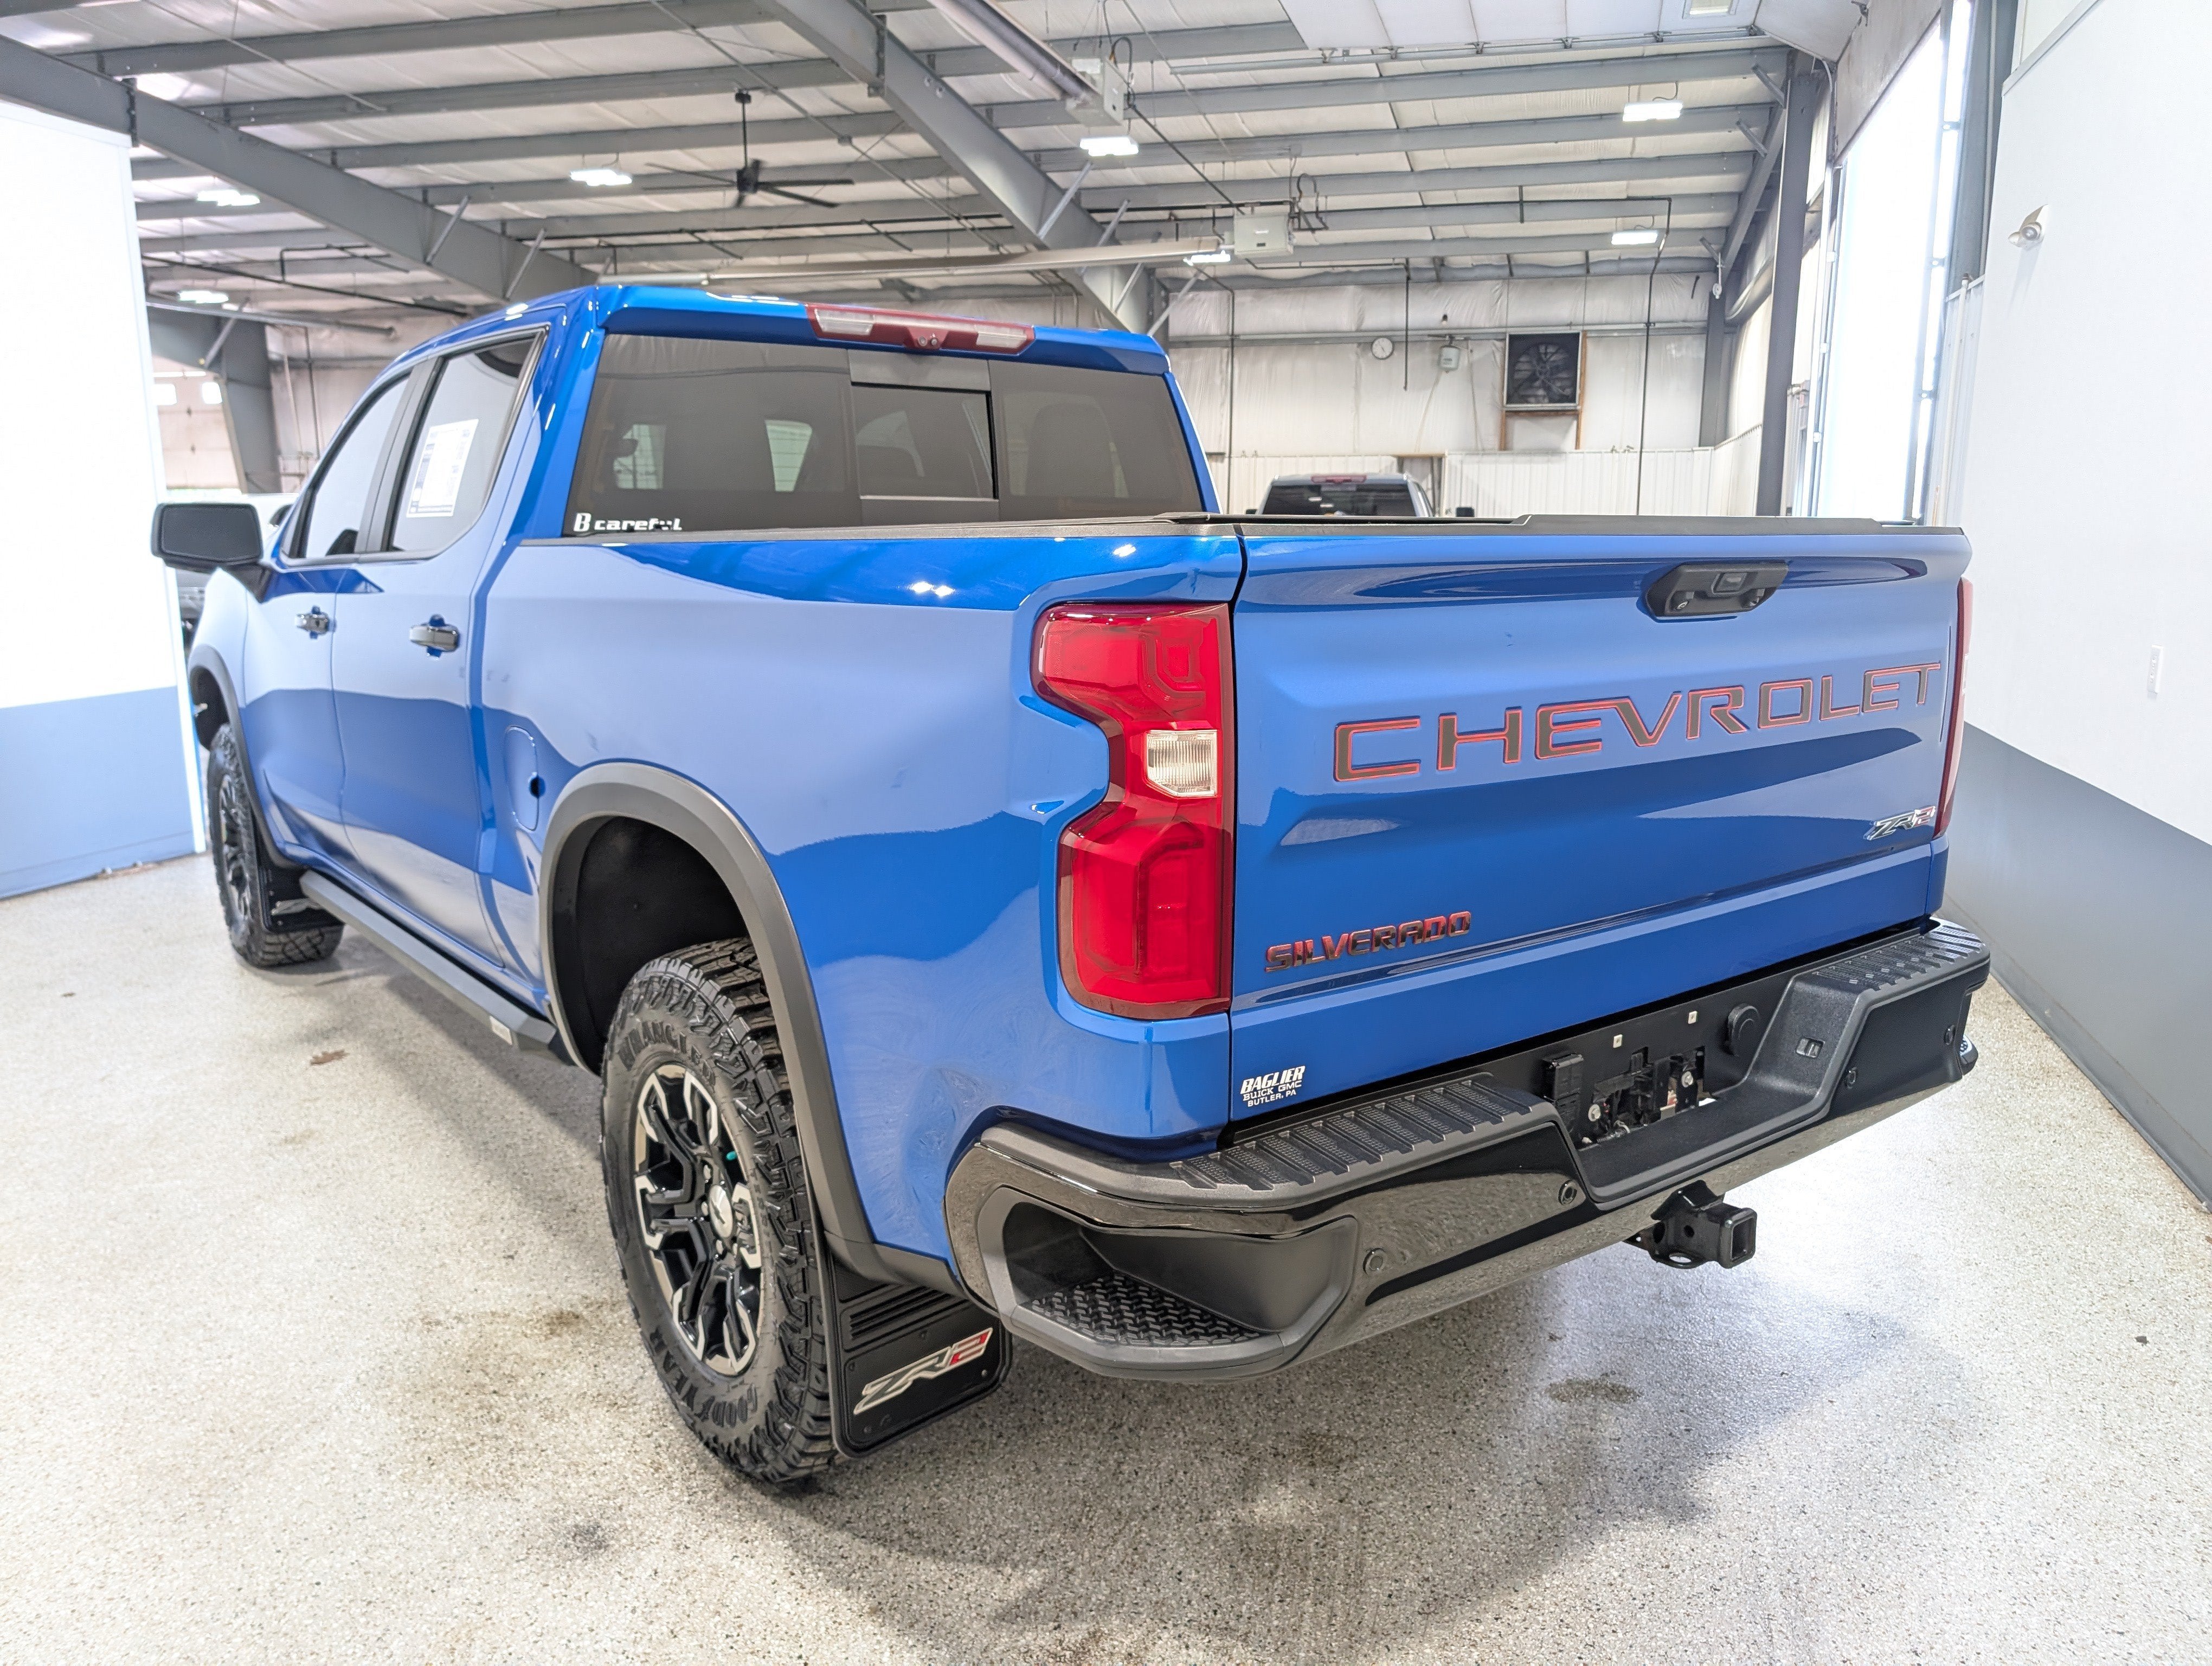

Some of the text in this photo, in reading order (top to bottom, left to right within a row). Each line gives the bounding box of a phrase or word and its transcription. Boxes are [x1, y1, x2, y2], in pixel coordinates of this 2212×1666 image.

[573, 512, 591, 532] B
[1333, 661, 1941, 782] CHEVROLET
[1863, 805, 1936, 841] ZR2
[1264, 911, 1472, 973] SILVERADO
[1240, 1065, 1306, 1094] BAGLIER
[1278, 1080, 1302, 1092] GMC
[1248, 1089, 1297, 1107] BUTLER, PA
[853, 1327, 993, 1415] ZR2
